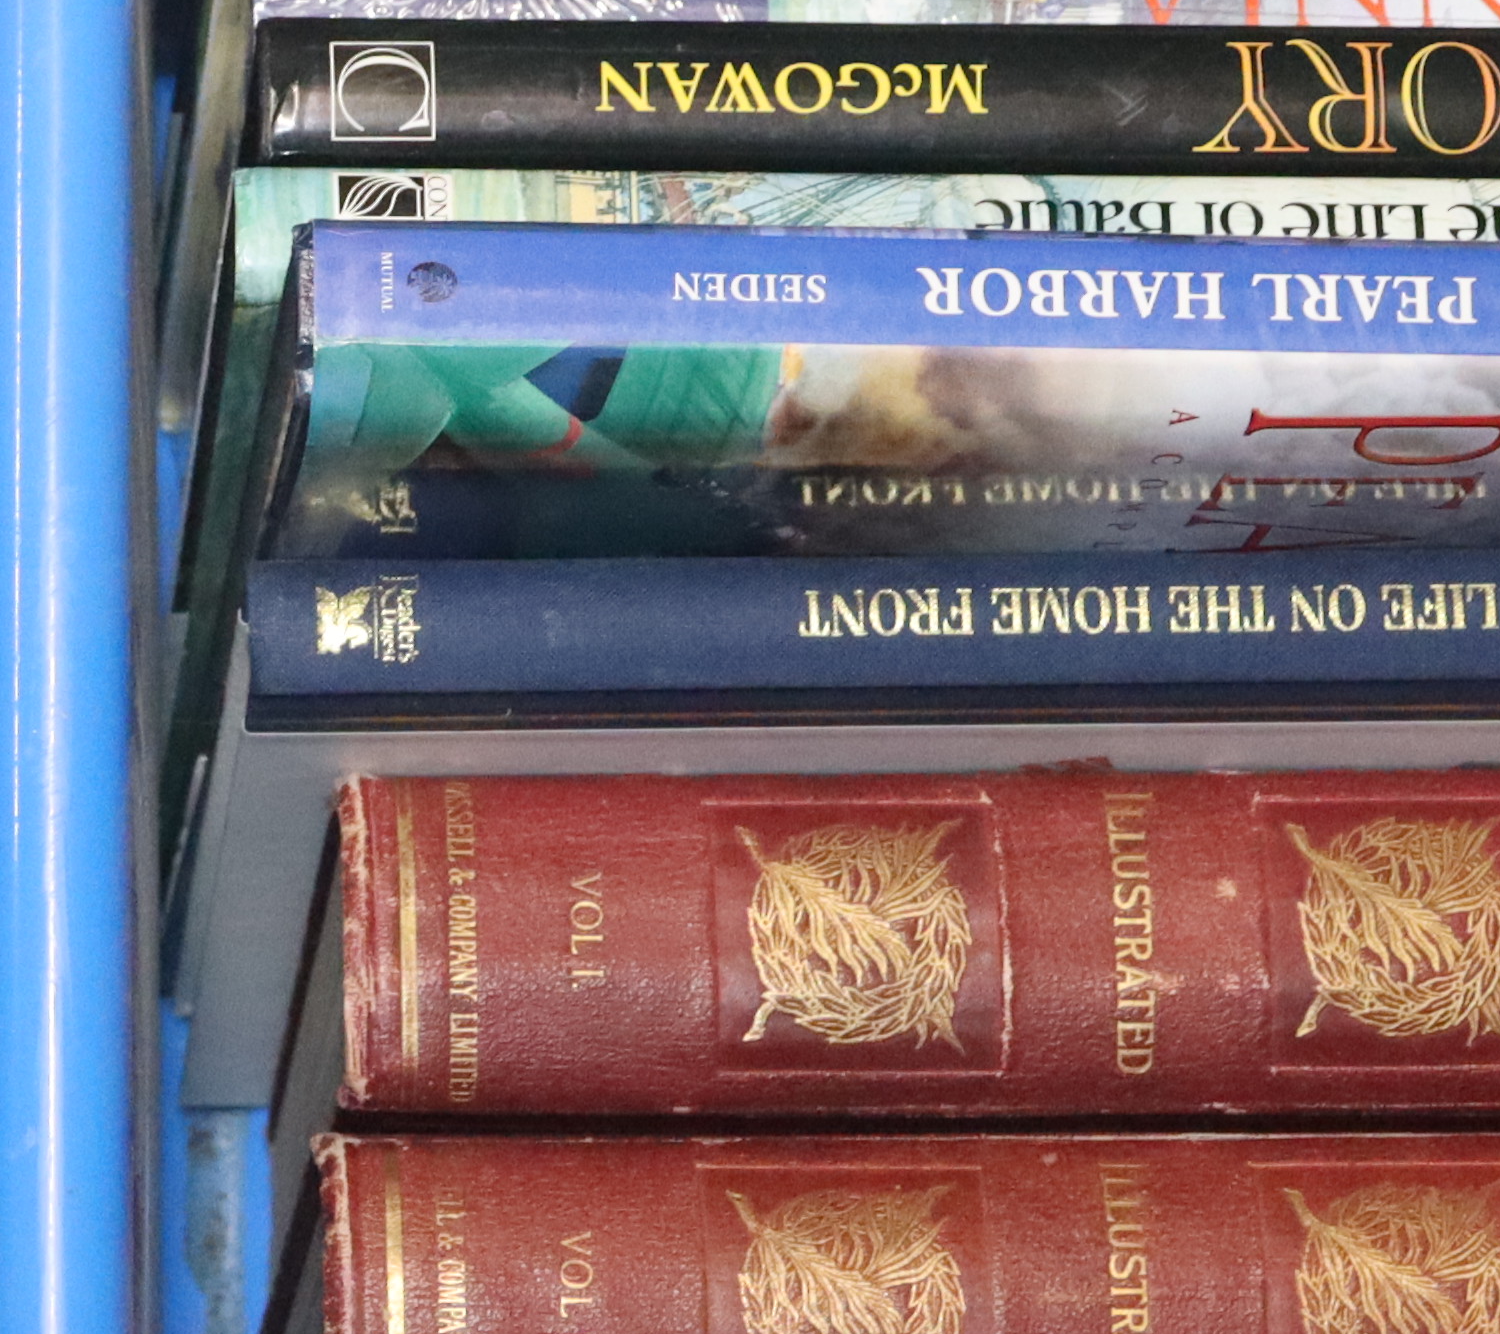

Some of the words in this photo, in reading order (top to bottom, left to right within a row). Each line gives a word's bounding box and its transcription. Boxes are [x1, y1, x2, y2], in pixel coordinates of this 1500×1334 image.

[596, 62, 987, 113] McGOWAN
[673, 273, 825, 302] SEIDEN
[917, 268, 1224, 319] HARBOR
[1253, 274, 1476, 323] PEARL
[799, 589, 973, 636] FRONT
[992, 587, 1150, 634] HOME
[1169, 586, 1274, 632] THE
[1291, 585, 1365, 631] ON
[1382, 584, 1496, 630] LIFE
